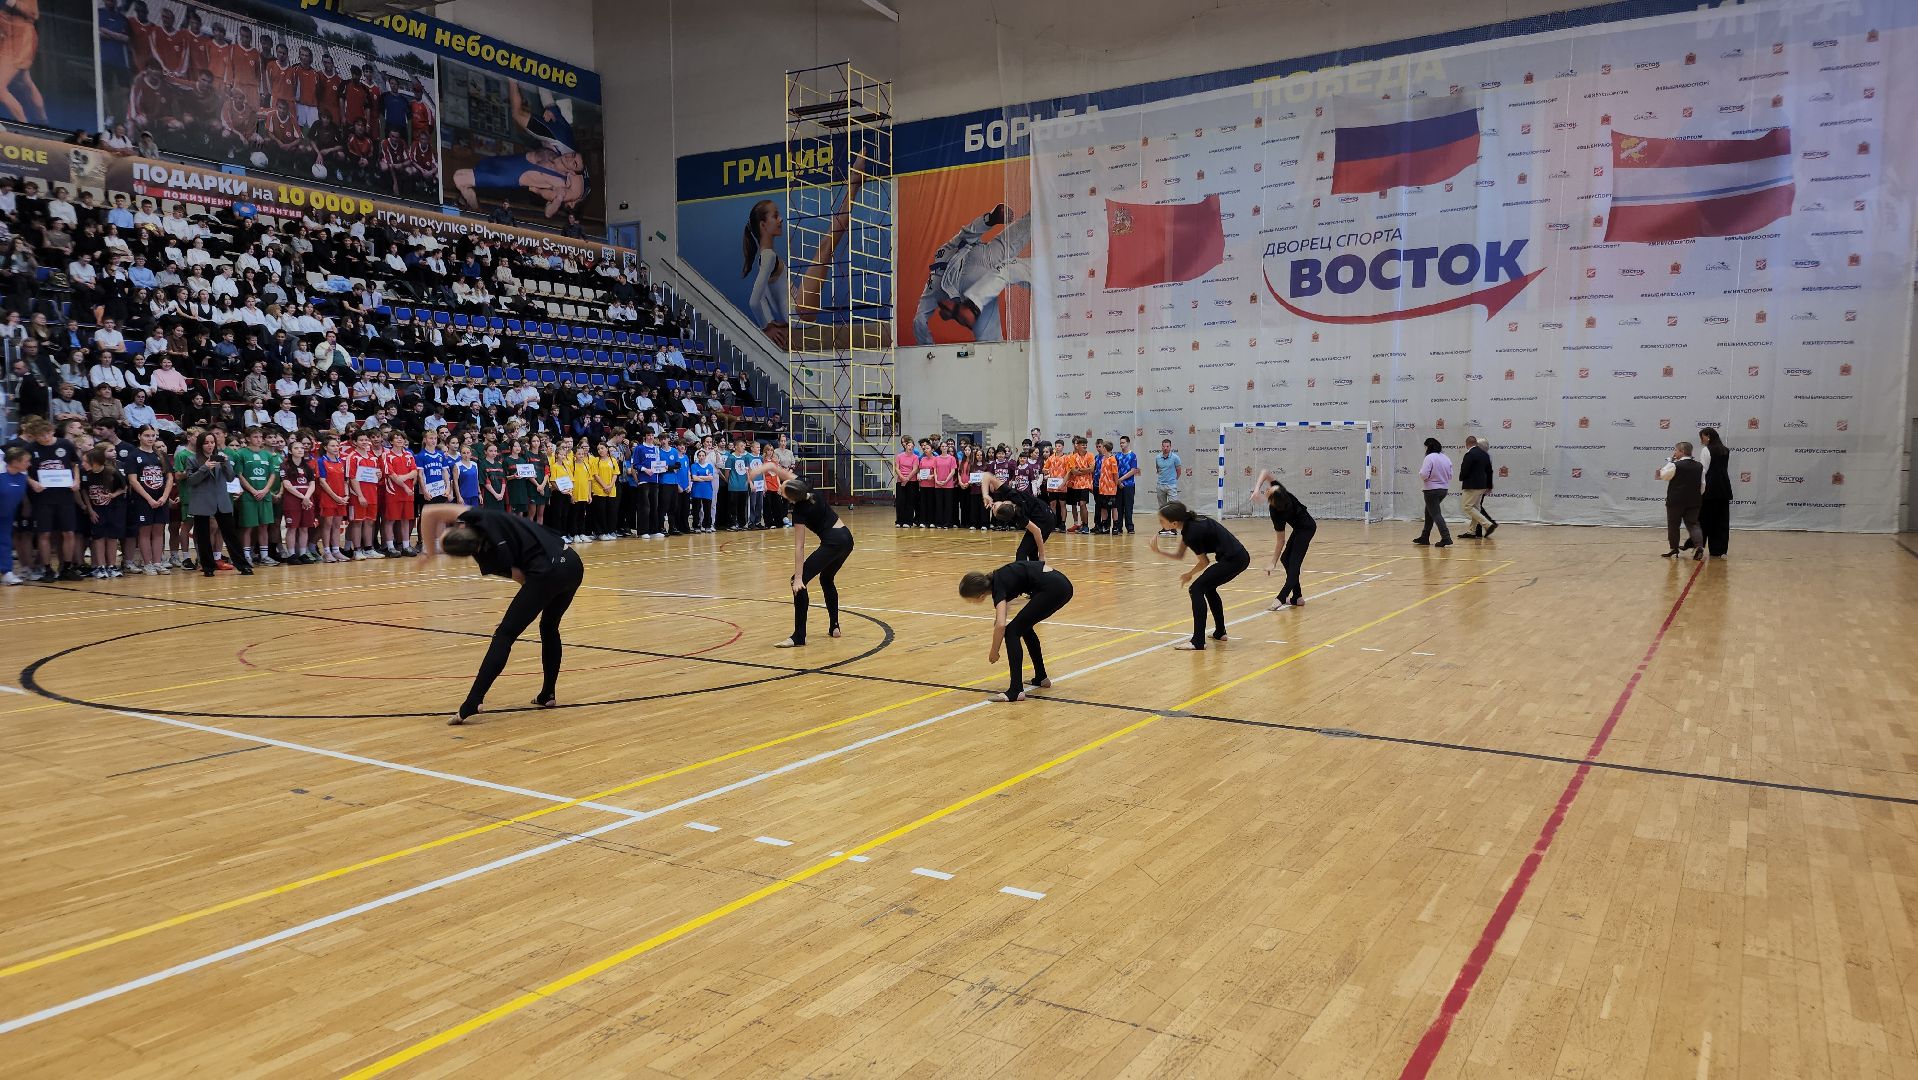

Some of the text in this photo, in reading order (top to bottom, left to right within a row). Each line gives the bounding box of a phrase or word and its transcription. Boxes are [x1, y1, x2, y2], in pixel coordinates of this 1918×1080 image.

[434, 27, 578, 89] небосклоне
[1252, 58, 1447, 108] ПОБЕДА
[964, 104, 1104, 153] БОРЬБА
[723, 146, 833, 186] ГРАЦИЯ
[132, 163, 248, 196] ПОДАРКИ
[252, 186, 273, 202] на
[277, 186, 306, 206] 10
[309, 191, 356, 215] 000
[377, 209, 405, 226] при
[408, 214, 468, 236] покупке
[470, 224, 515, 242] iPhone
[517, 235, 540, 249] или
[542, 239, 595, 262] Samsung
[1263, 227, 1402, 258] ДВОРЕЦ СПОРТА
[1290, 239, 1529, 298] ВОСТОК
